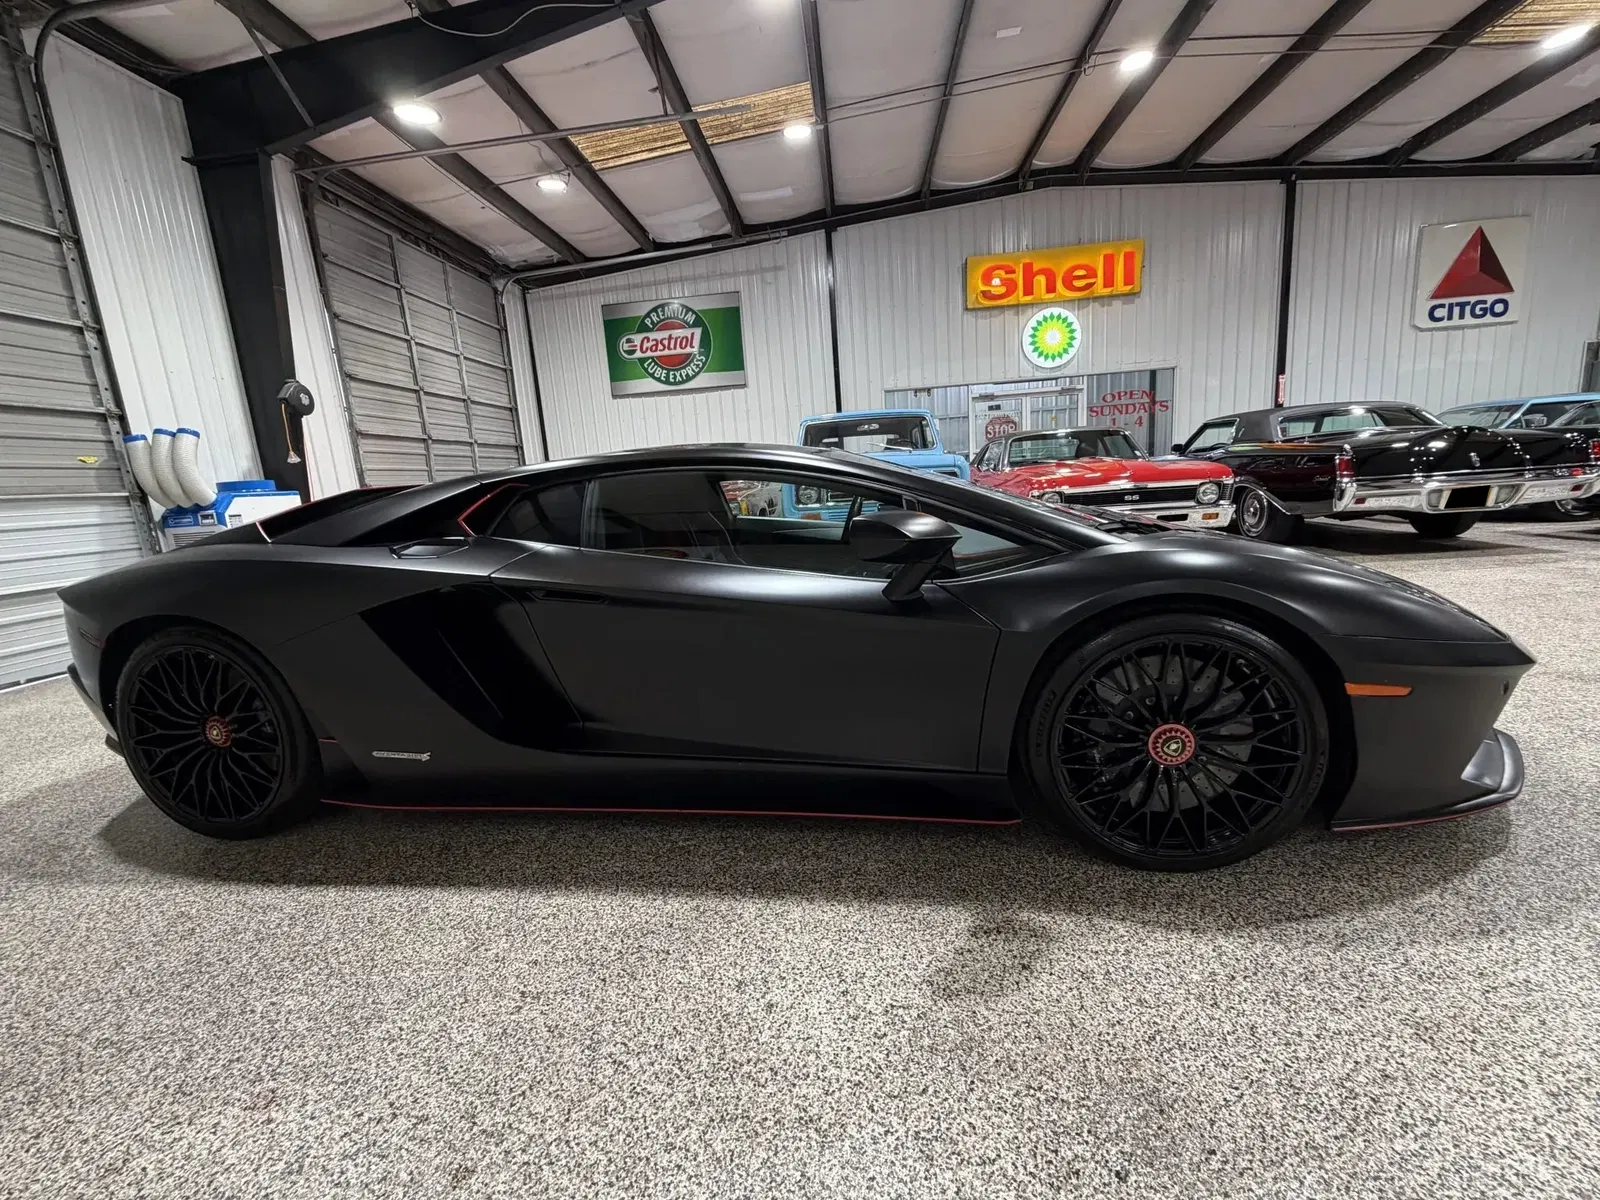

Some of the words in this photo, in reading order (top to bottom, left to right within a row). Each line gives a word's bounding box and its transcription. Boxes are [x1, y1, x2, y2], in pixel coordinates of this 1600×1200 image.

[980, 250, 1136, 300] Shell
[644, 304, 697, 328] PREMIUM
[1427, 298, 1509, 322] CITGO
[639, 332, 696, 354] Castrol
[644, 358, 667, 381] LUBE
[669, 354, 706, 382] EXPRESS
[1102, 390, 1154, 403] OPEN
[1089, 400, 1170, 417] SUNDAYS
[986, 423, 1016, 438] STOP
[1111, 417, 1116, 427] 1
[1135, 415, 1144, 427] 4
